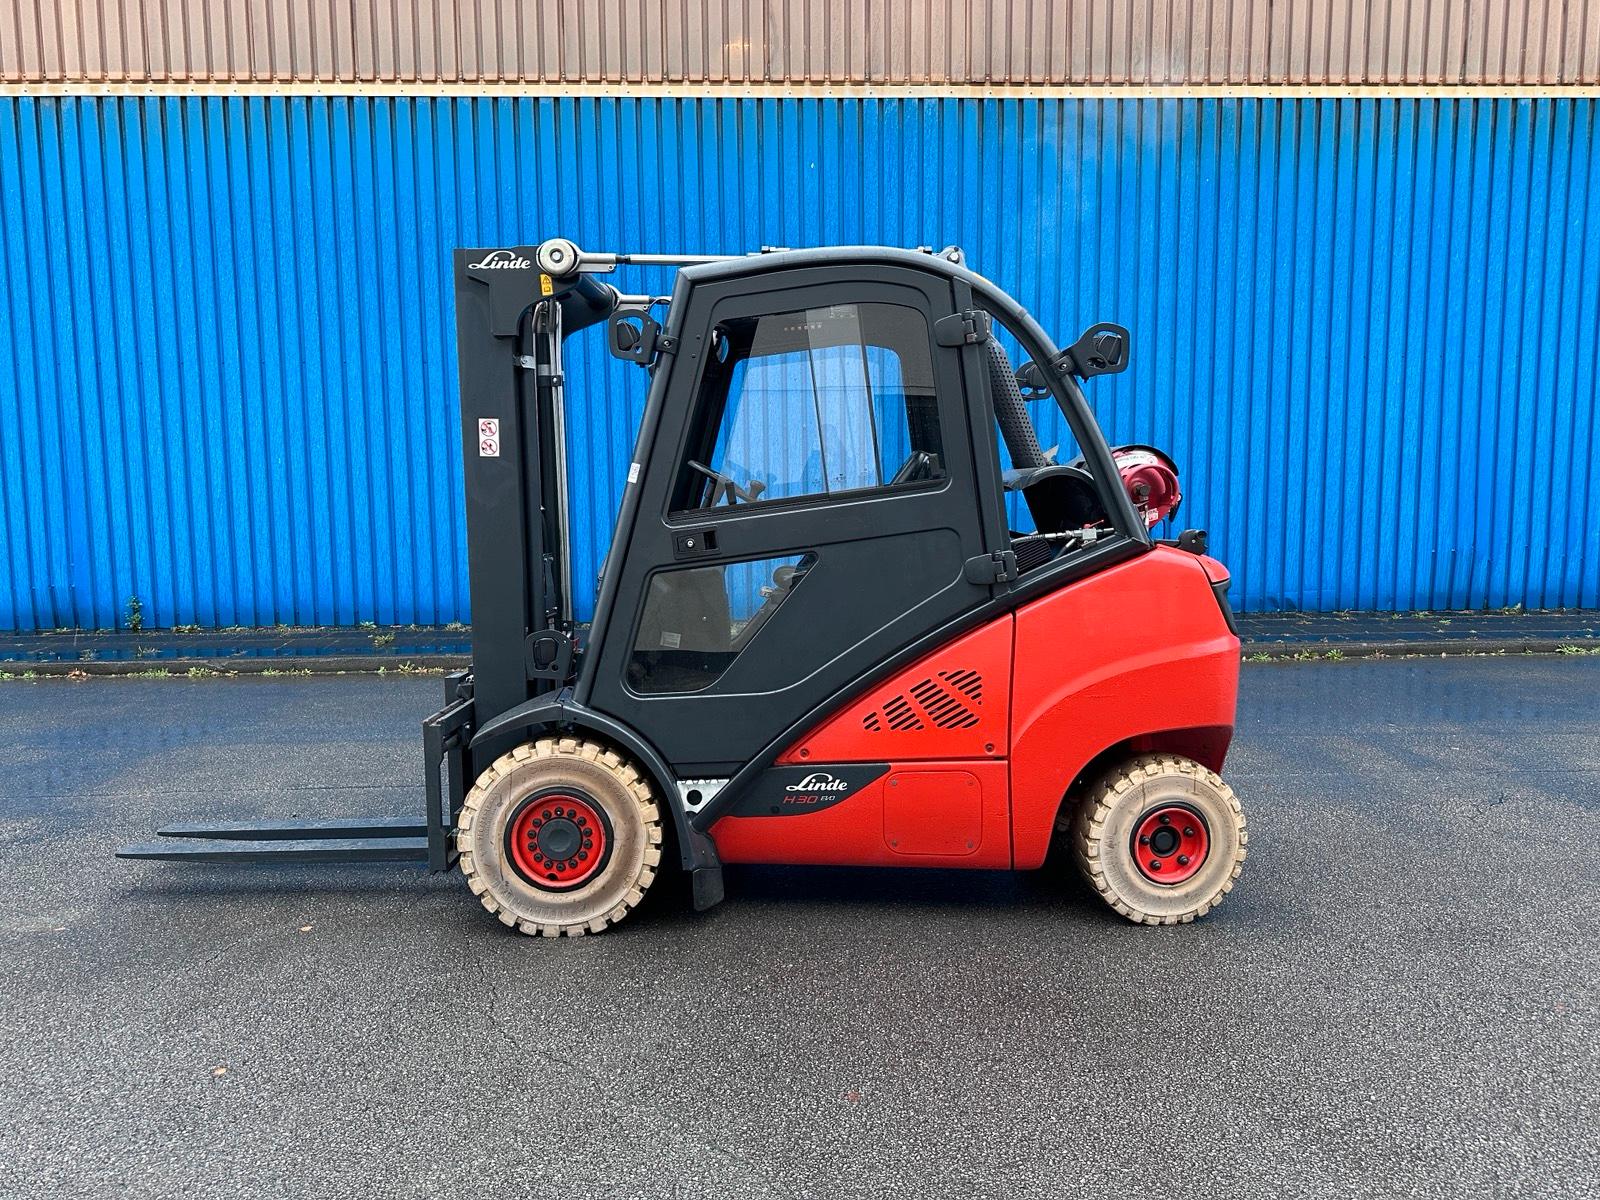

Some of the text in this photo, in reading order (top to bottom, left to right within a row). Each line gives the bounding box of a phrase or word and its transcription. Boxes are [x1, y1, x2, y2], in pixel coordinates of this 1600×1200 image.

[468, 250, 531, 270] Linde
[786, 772, 848, 792] Linde
[783, 795, 818, 804] H30
